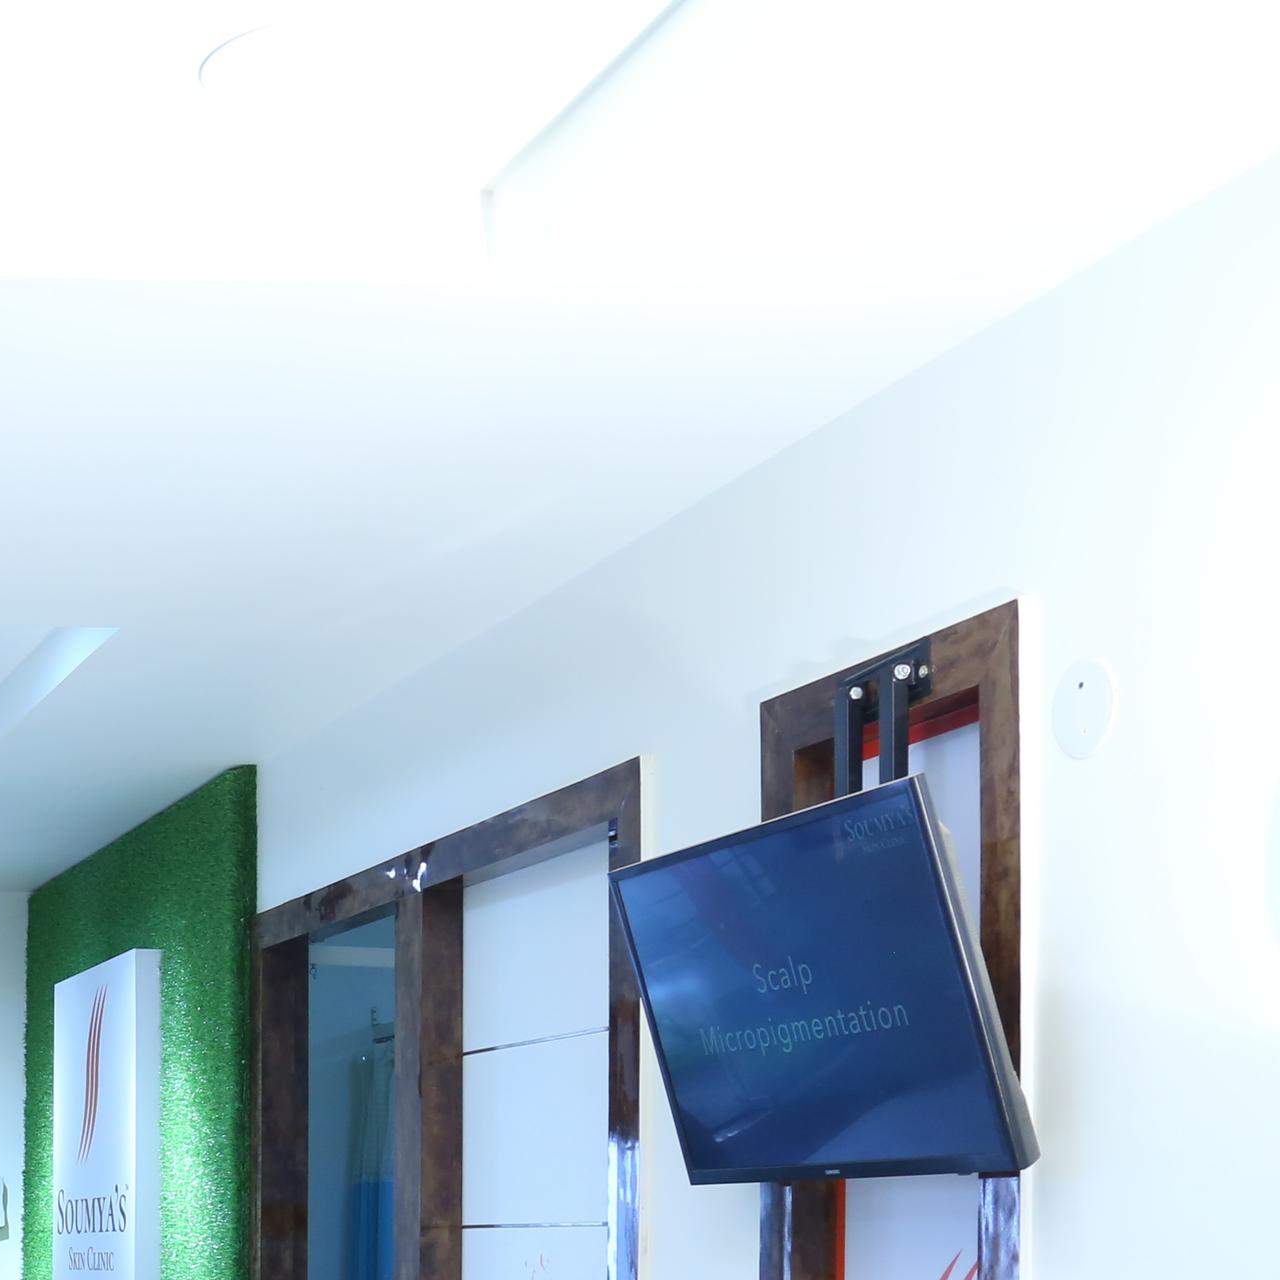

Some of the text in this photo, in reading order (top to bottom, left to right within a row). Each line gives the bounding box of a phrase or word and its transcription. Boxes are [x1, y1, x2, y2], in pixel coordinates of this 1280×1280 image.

[752, 955, 813, 995] Scalp
[699, 1000, 910, 1057] Micropigmentation
[57, 1184, 127, 1235] SOUMYA'S
[68, 1246, 114, 1271] SKIN CLINIC
